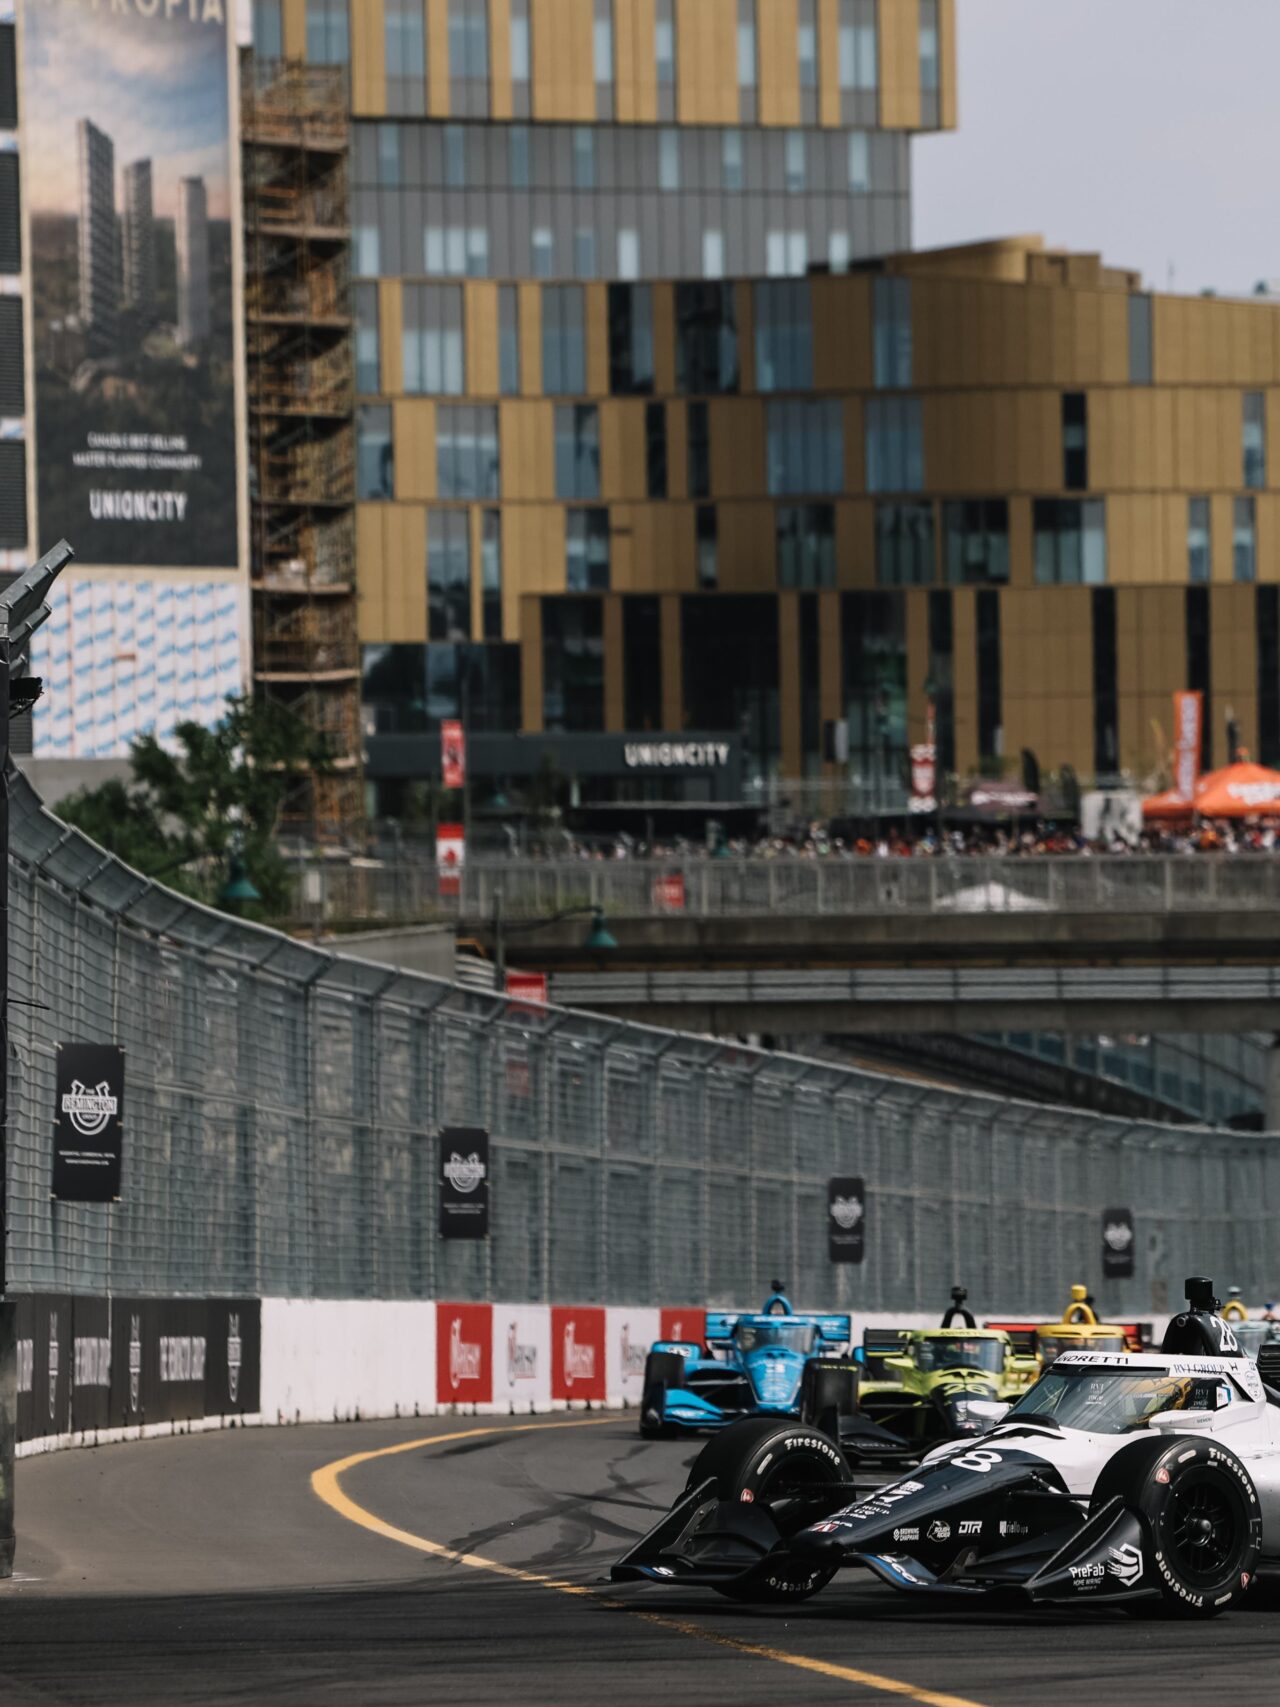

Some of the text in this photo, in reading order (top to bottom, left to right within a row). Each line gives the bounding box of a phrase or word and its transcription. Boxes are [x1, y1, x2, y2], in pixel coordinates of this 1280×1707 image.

[89, 489, 188, 521] UNIONCITY
[624, 742, 729, 767] UNIONCITY
[1209, 1315, 1238, 1352] 28
[943, 1383, 989, 1396] 26
[784, 1437, 841, 1467] Firestone
[1208, 1447, 1256, 1504] Firestone
[958, 1521, 983, 1534] DTR
[1068, 1562, 1105, 1579] PreFab
[1155, 1551, 1204, 1608] Firestone
